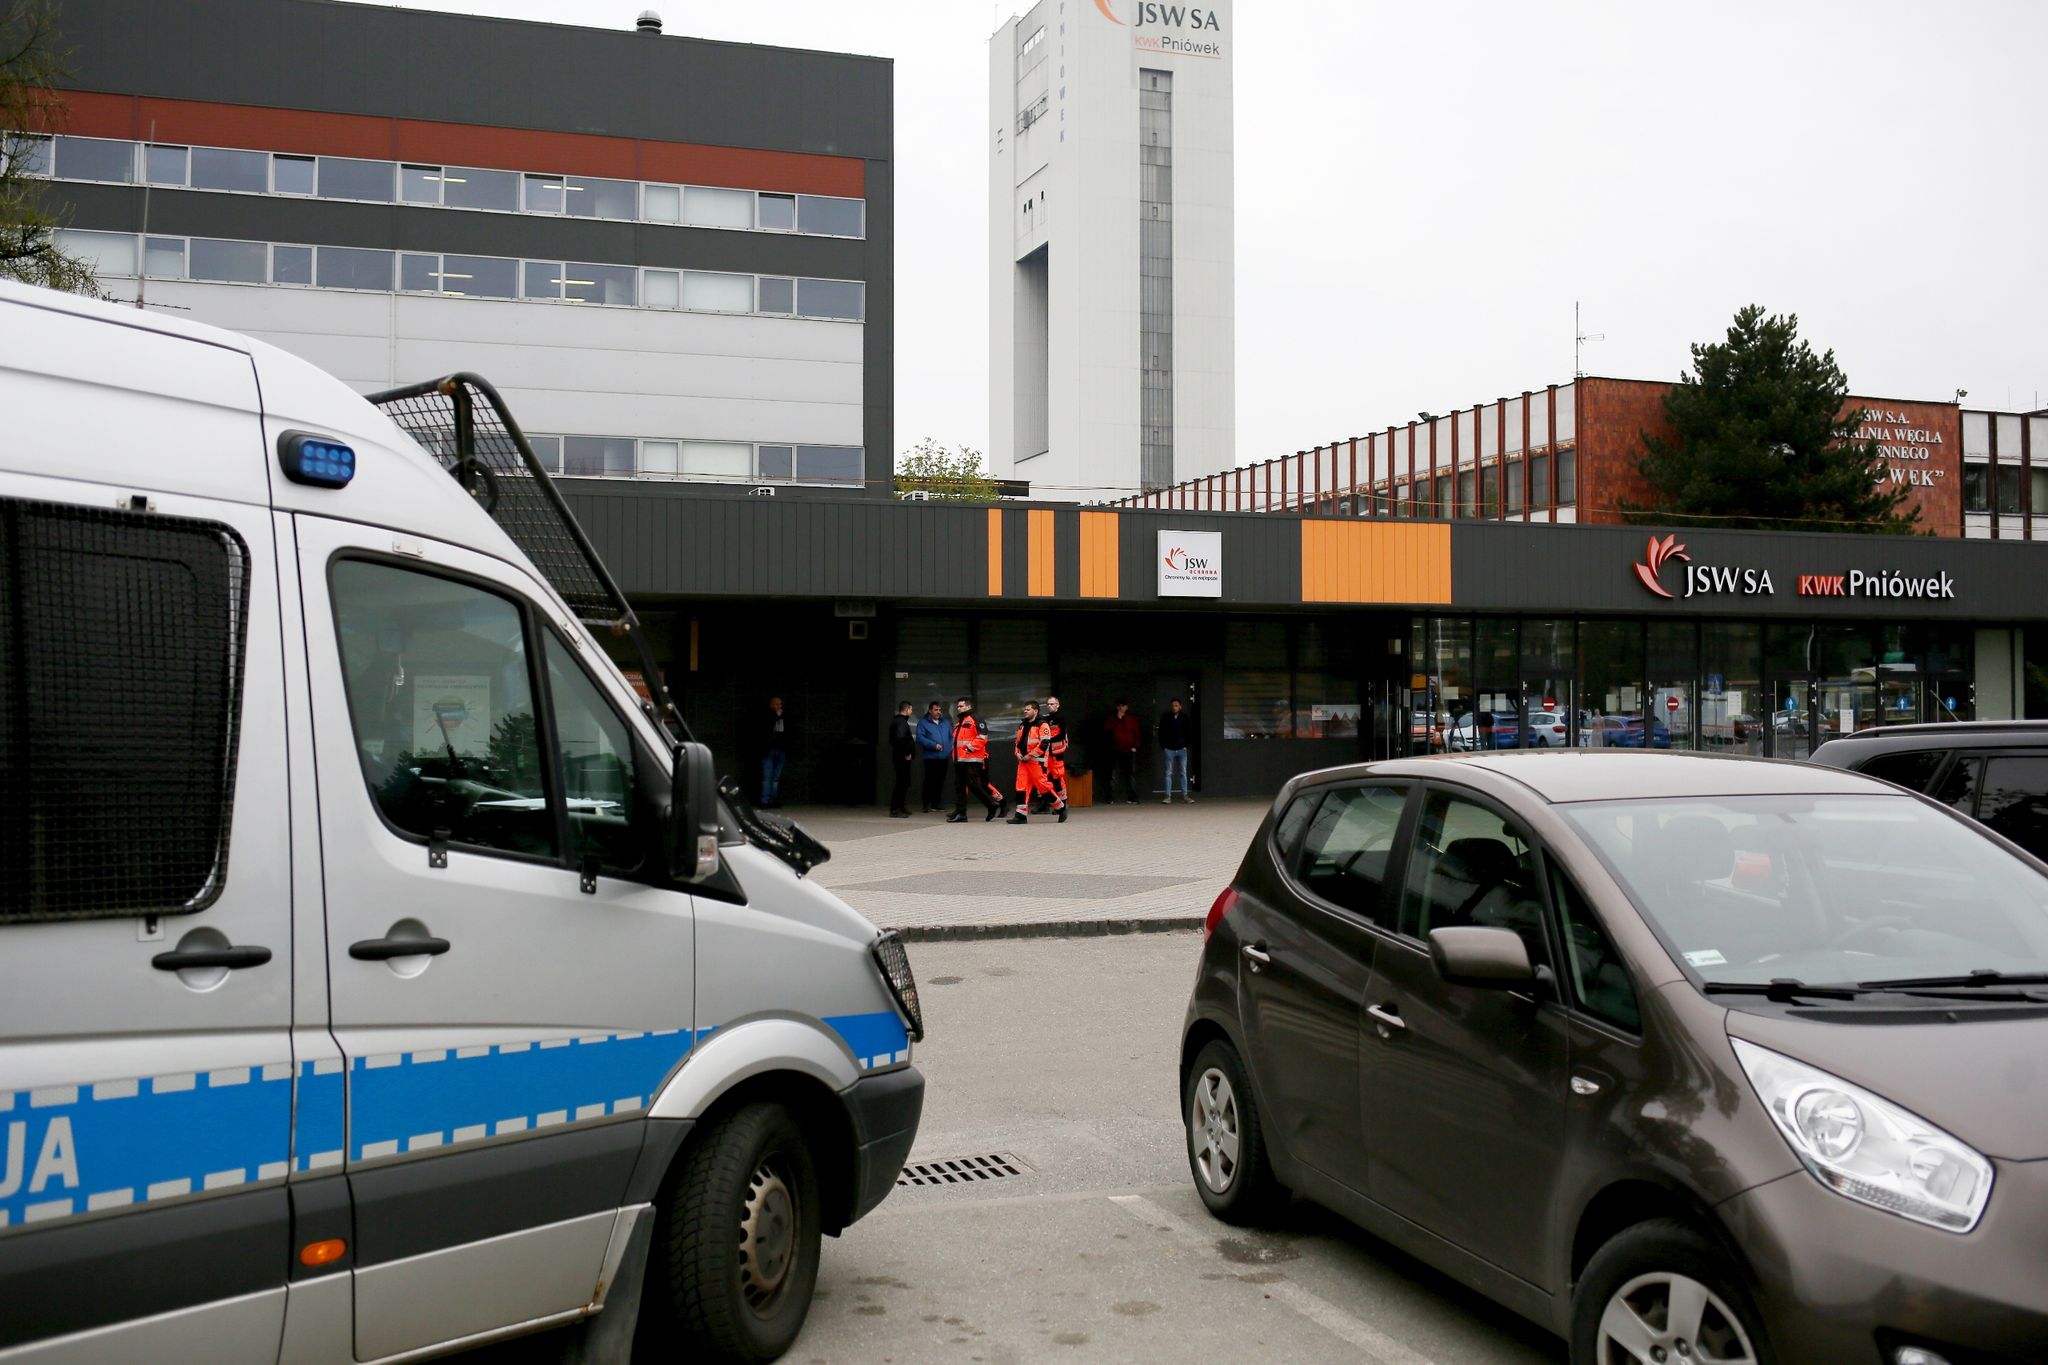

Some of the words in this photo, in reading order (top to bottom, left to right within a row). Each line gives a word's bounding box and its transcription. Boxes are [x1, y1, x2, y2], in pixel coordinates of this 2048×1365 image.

[1136, 1, 1186, 27] JSW
[1191, 8, 1220, 31] SA
[1135, 36, 1161, 48] KWK
[1161, 36, 1221, 56] Pniówek
[1886, 409, 1910, 424] S.A.
[1893, 427, 1943, 445] WĘGLA
[1185, 558, 1208, 570] JSW
[1684, 566, 1740, 598] JSW
[1744, 569, 1775, 595] SA
[1800, 575, 1845, 596] KWK
[1849, 569, 1955, 599] Pniówek
